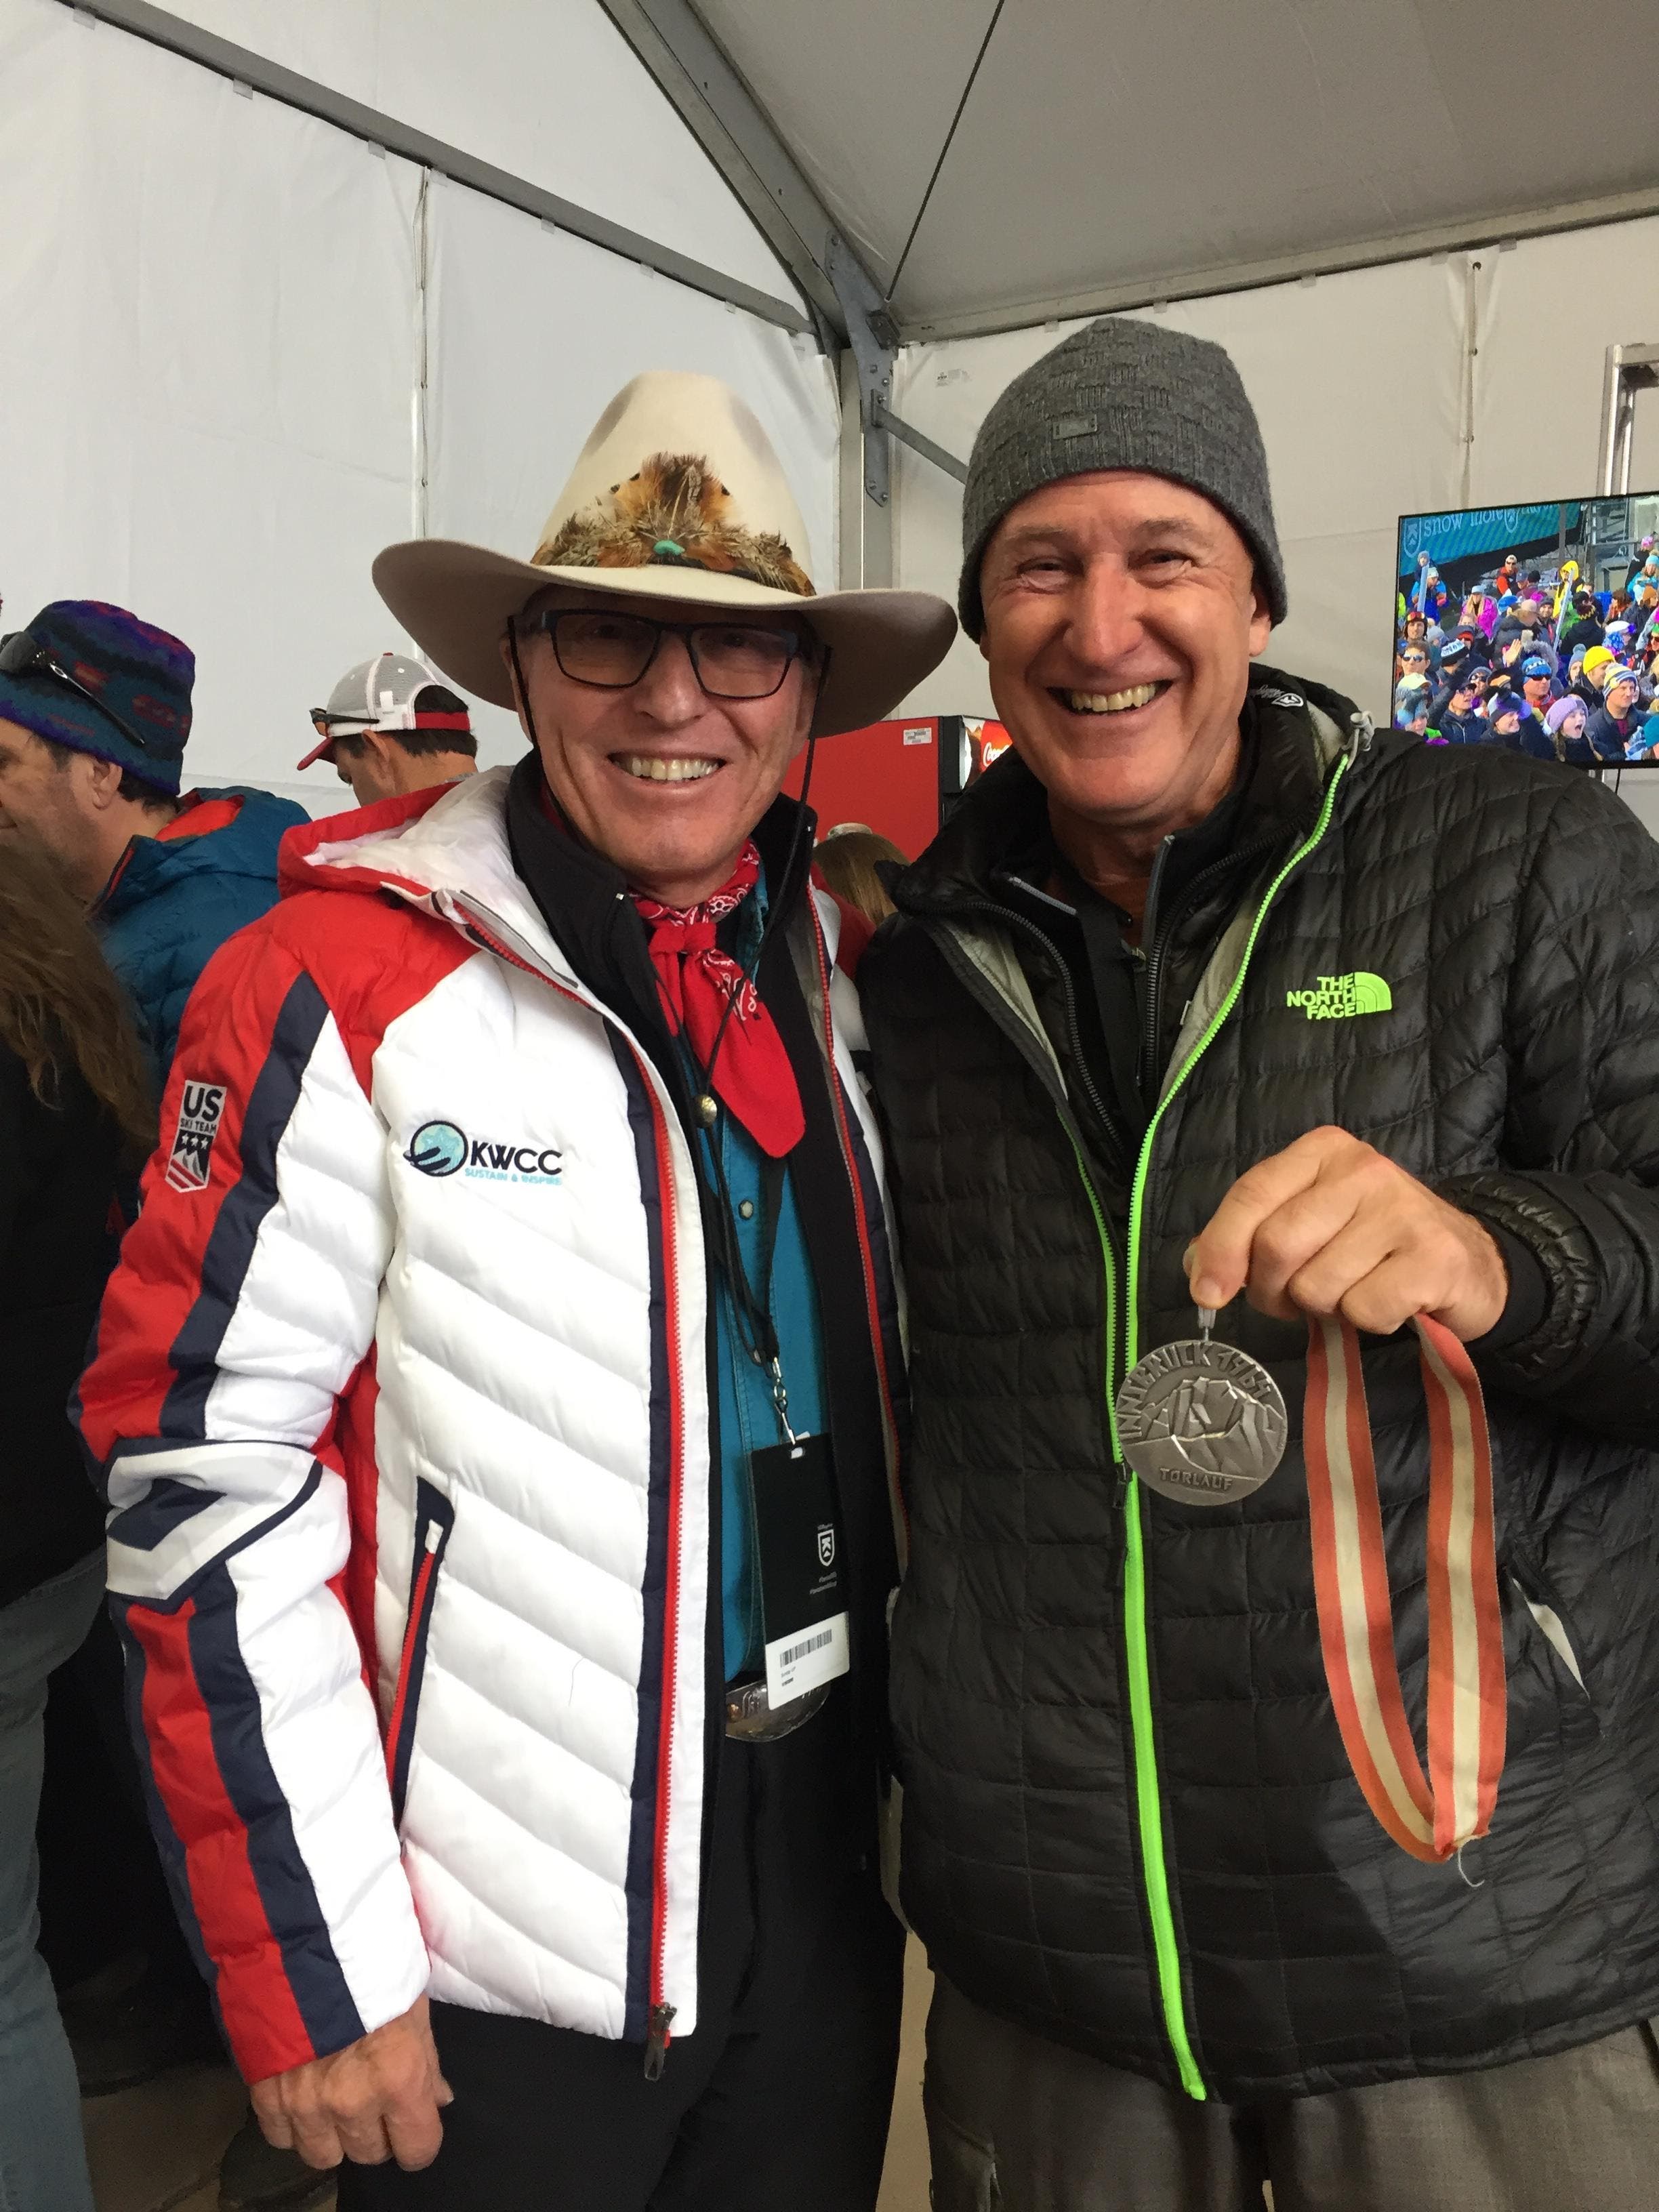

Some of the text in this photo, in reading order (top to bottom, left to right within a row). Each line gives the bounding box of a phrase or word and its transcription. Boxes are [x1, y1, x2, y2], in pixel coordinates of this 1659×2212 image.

[1424, 513, 1463, 537] snow
[1316, 972, 1354, 991] THE
[1286, 987, 1355, 1008] NORTH
[1306, 1002, 1356, 1020] FACE
[183, 1085, 223, 1122] US
[180, 1118, 217, 1134] SKI TEAM
[470, 1140, 562, 1176] KWCC
[464, 1167, 508, 1181] SUSTAIN
[1118, 1342, 1211, 1437] INNSBRUCK
[1159, 1467, 1233, 1492] TORLAUF
